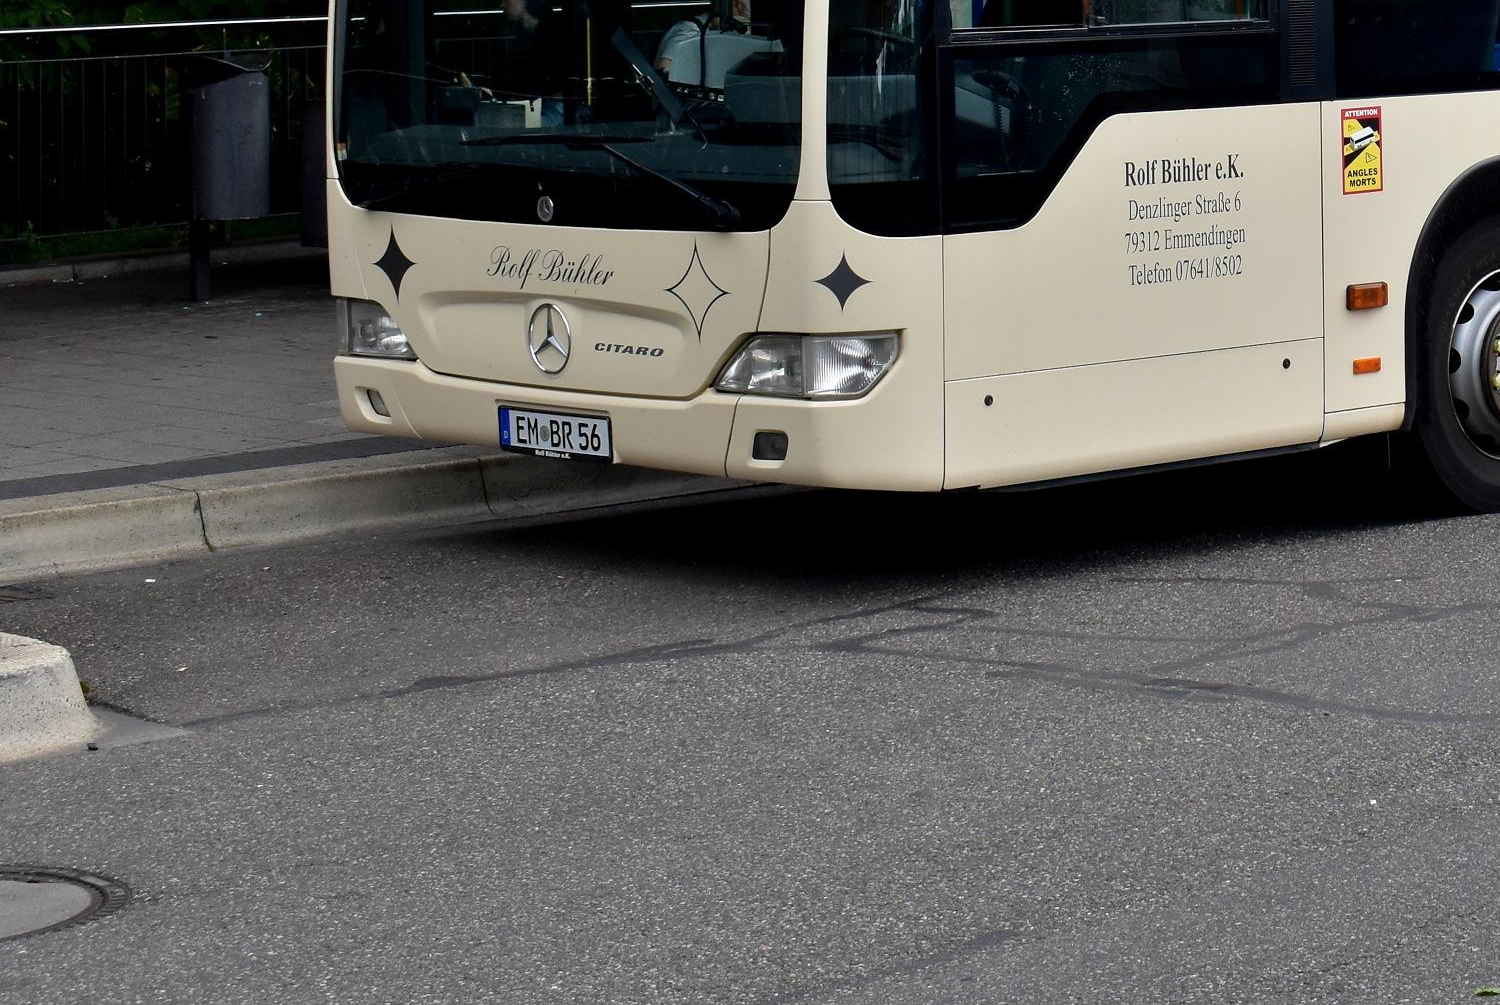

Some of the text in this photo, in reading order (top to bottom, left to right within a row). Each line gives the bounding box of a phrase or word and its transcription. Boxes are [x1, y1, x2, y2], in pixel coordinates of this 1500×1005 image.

[1344, 108, 1378, 118] ATTENTION
[1124, 153, 1244, 187] Rolf Bühler e.K.
[1347, 167, 1378, 178] ANGLES
[1349, 177, 1377, 187] MORTS
[1128, 191, 1242, 223] Denzlinger Straße 6
[1124, 225, 1246, 254] 79312 Emmendingen
[487, 245, 615, 290] Rolf Bühler
[1128, 254, 1243, 286] Telefon 07641/8502
[594, 342, 665, 357] CITARO
[516, 415, 539, 445] EM
[550, 419, 574, 449] BR
[578, 422, 602, 452] 56
